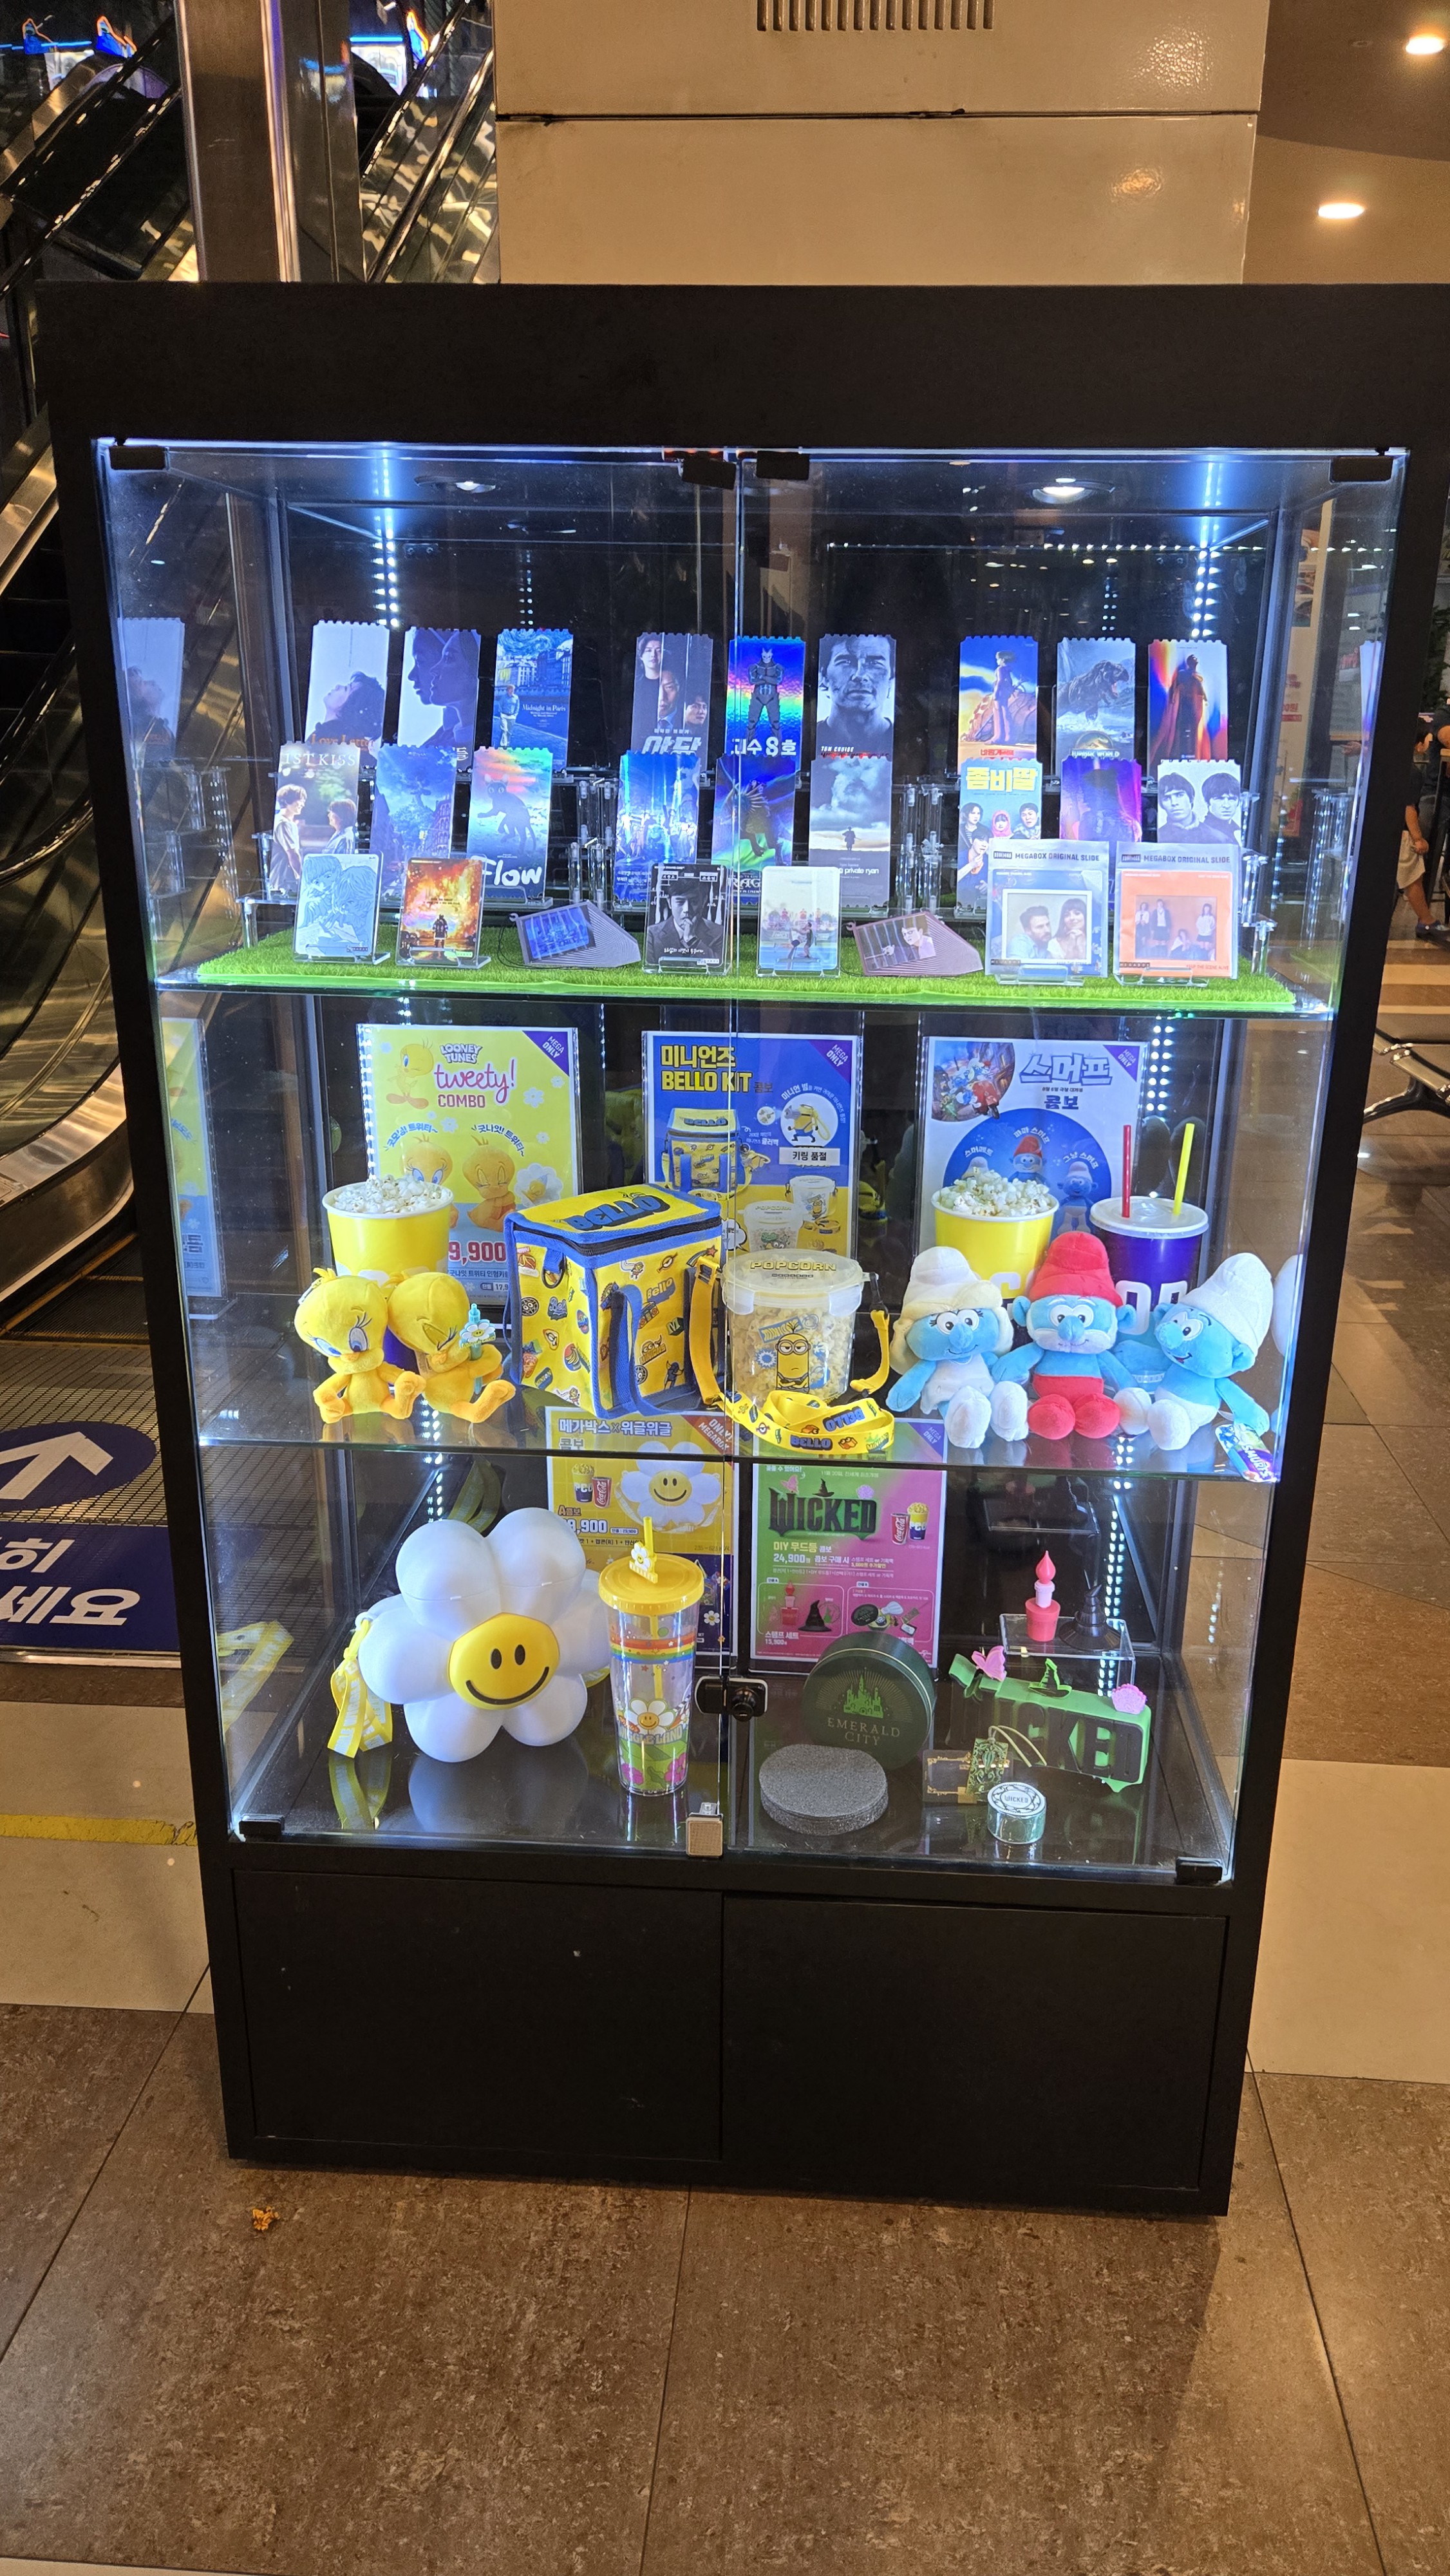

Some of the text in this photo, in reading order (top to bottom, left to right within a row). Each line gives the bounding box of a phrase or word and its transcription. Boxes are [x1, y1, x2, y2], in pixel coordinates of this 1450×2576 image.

[284, 753, 355, 766] 1ST KISS
[966, 766, 1038, 792] 좀비딸
[471, 855, 543, 886] Flow
[440, 1043, 483, 1056] LOONEY
[541, 1041, 561, 1059] ONLY
[547, 1036, 565, 1054] MEGA
[831, 1044, 849, 1063] MEGA
[444, 1053, 479, 1064] TUNES
[661, 1045, 737, 1069] 미니언즈
[826, 1050, 843, 1067] ONLY
[1118, 1054, 1132, 1068] ONLY
[1122, 1048, 1136, 1063] MEGA
[1019, 1052, 1113, 1086] 스머프
[434, 1059, 514, 1104] tweety!
[661, 1070, 753, 1094] BELLO KIT
[781, 1084, 801, 1100] 미니언
[438, 1094, 485, 1108] COMBO
[793, 1151, 827, 1161] 키링 품절
[565, 1195, 671, 1231] BELLO
[750, 1261, 836, 1271] POPCORN
[646, 1278, 673, 1299] Bello
[822, 1406, 866, 1432] BELLO
[559, 1419, 611, 1434] 메가박스
[621, 1421, 672, 1437] 위글위글
[927, 1426, 941, 1441] MEGA
[790, 1435, 833, 1451] BELLO
[923, 1430, 937, 1444] ONLY
[768, 1488, 878, 1537] WICKED
[773, 1541, 789, 1551] DIY
[791, 1542, 818, 1553] 무드등
[842, 1556, 849, 1564] 시
[655, 1723, 683, 1746] LAND
[827, 1717, 900, 1738] EMERALD
[844, 1731, 880, 1746] CITY
[1004, 1790, 1029, 1804] WICKED
